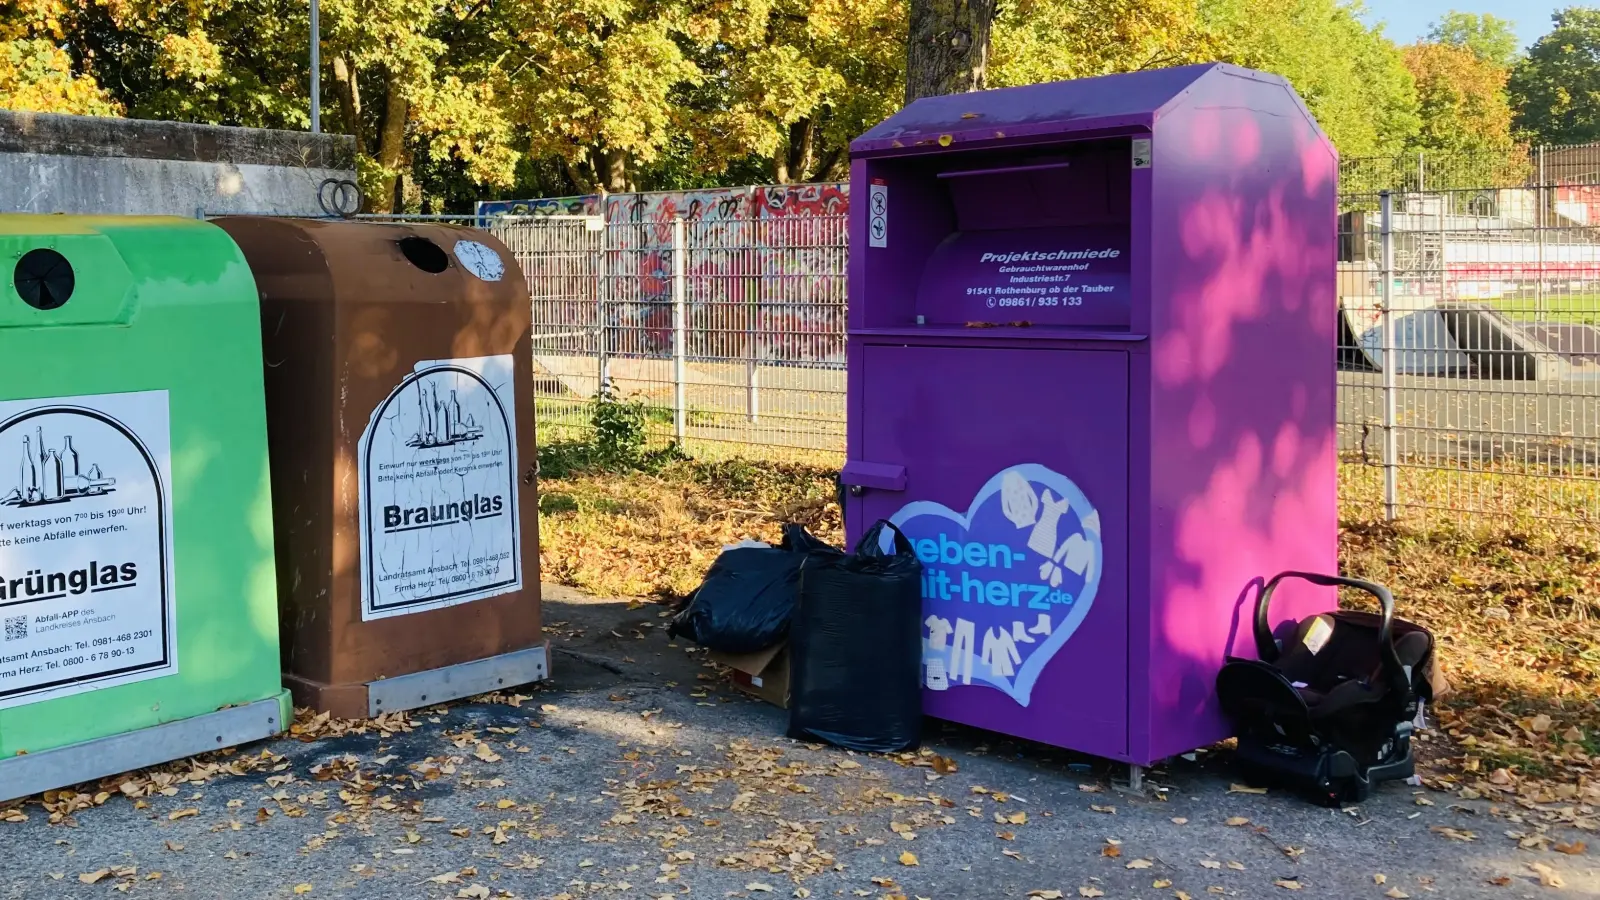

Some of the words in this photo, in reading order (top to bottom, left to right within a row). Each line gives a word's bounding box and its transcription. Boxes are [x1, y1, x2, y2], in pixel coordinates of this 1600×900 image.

[980, 248, 1120, 264] Projektschmiede
[999, 263, 1089, 273] Gebrauchtwarenhof
[1009, 274, 1071, 283] Industriestr.7
[966, 287, 992, 295] 91541
[995, 286, 1047, 296] Rothenburg
[1049, 285, 1060, 294] ob
[1062, 285, 1079, 294] der
[1081, 284, 1115, 293] Tauber
[1038, 297, 1059, 307] 935
[1062, 296, 1083, 306] 133
[379, 461, 405, 471] Einwurf
[419, 457, 450, 467] werktags
[451, 455, 462, 463] von
[378, 474, 394, 482] Bitte
[395, 473, 414, 481] keine
[439, 467, 453, 475] oder
[454, 463, 477, 474] Keramik
[6, 517, 51, 530] werktags
[54, 516, 72, 525] von
[90, 511, 104, 521] bis
[127, 505, 147, 516] Uhr!
[384, 493, 503, 529] Braunglas
[14, 534, 41, 545] keine
[43, 528, 76, 542] Abfälle
[78, 524, 128, 537] einwerfen.
[379, 567, 426, 582] Landratsamt
[394, 583, 416, 592] Firma
[451, 573, 466, 583] 0800
[35, 609, 79, 624] Abfall-APP
[80, 608, 95, 617] des
[35, 619, 82, 634] Landkreises
[82, 613, 116, 626] Ansbach
[31, 643, 73, 659] Ansbach:
[75, 640, 90, 651] Tel.
[92, 632, 132, 647] 0981-468
[133, 629, 153, 641] 2301
[19, 664, 43, 675] Herz:
[45, 661, 61, 671] Tel.
[63, 655, 84, 667] 0800
